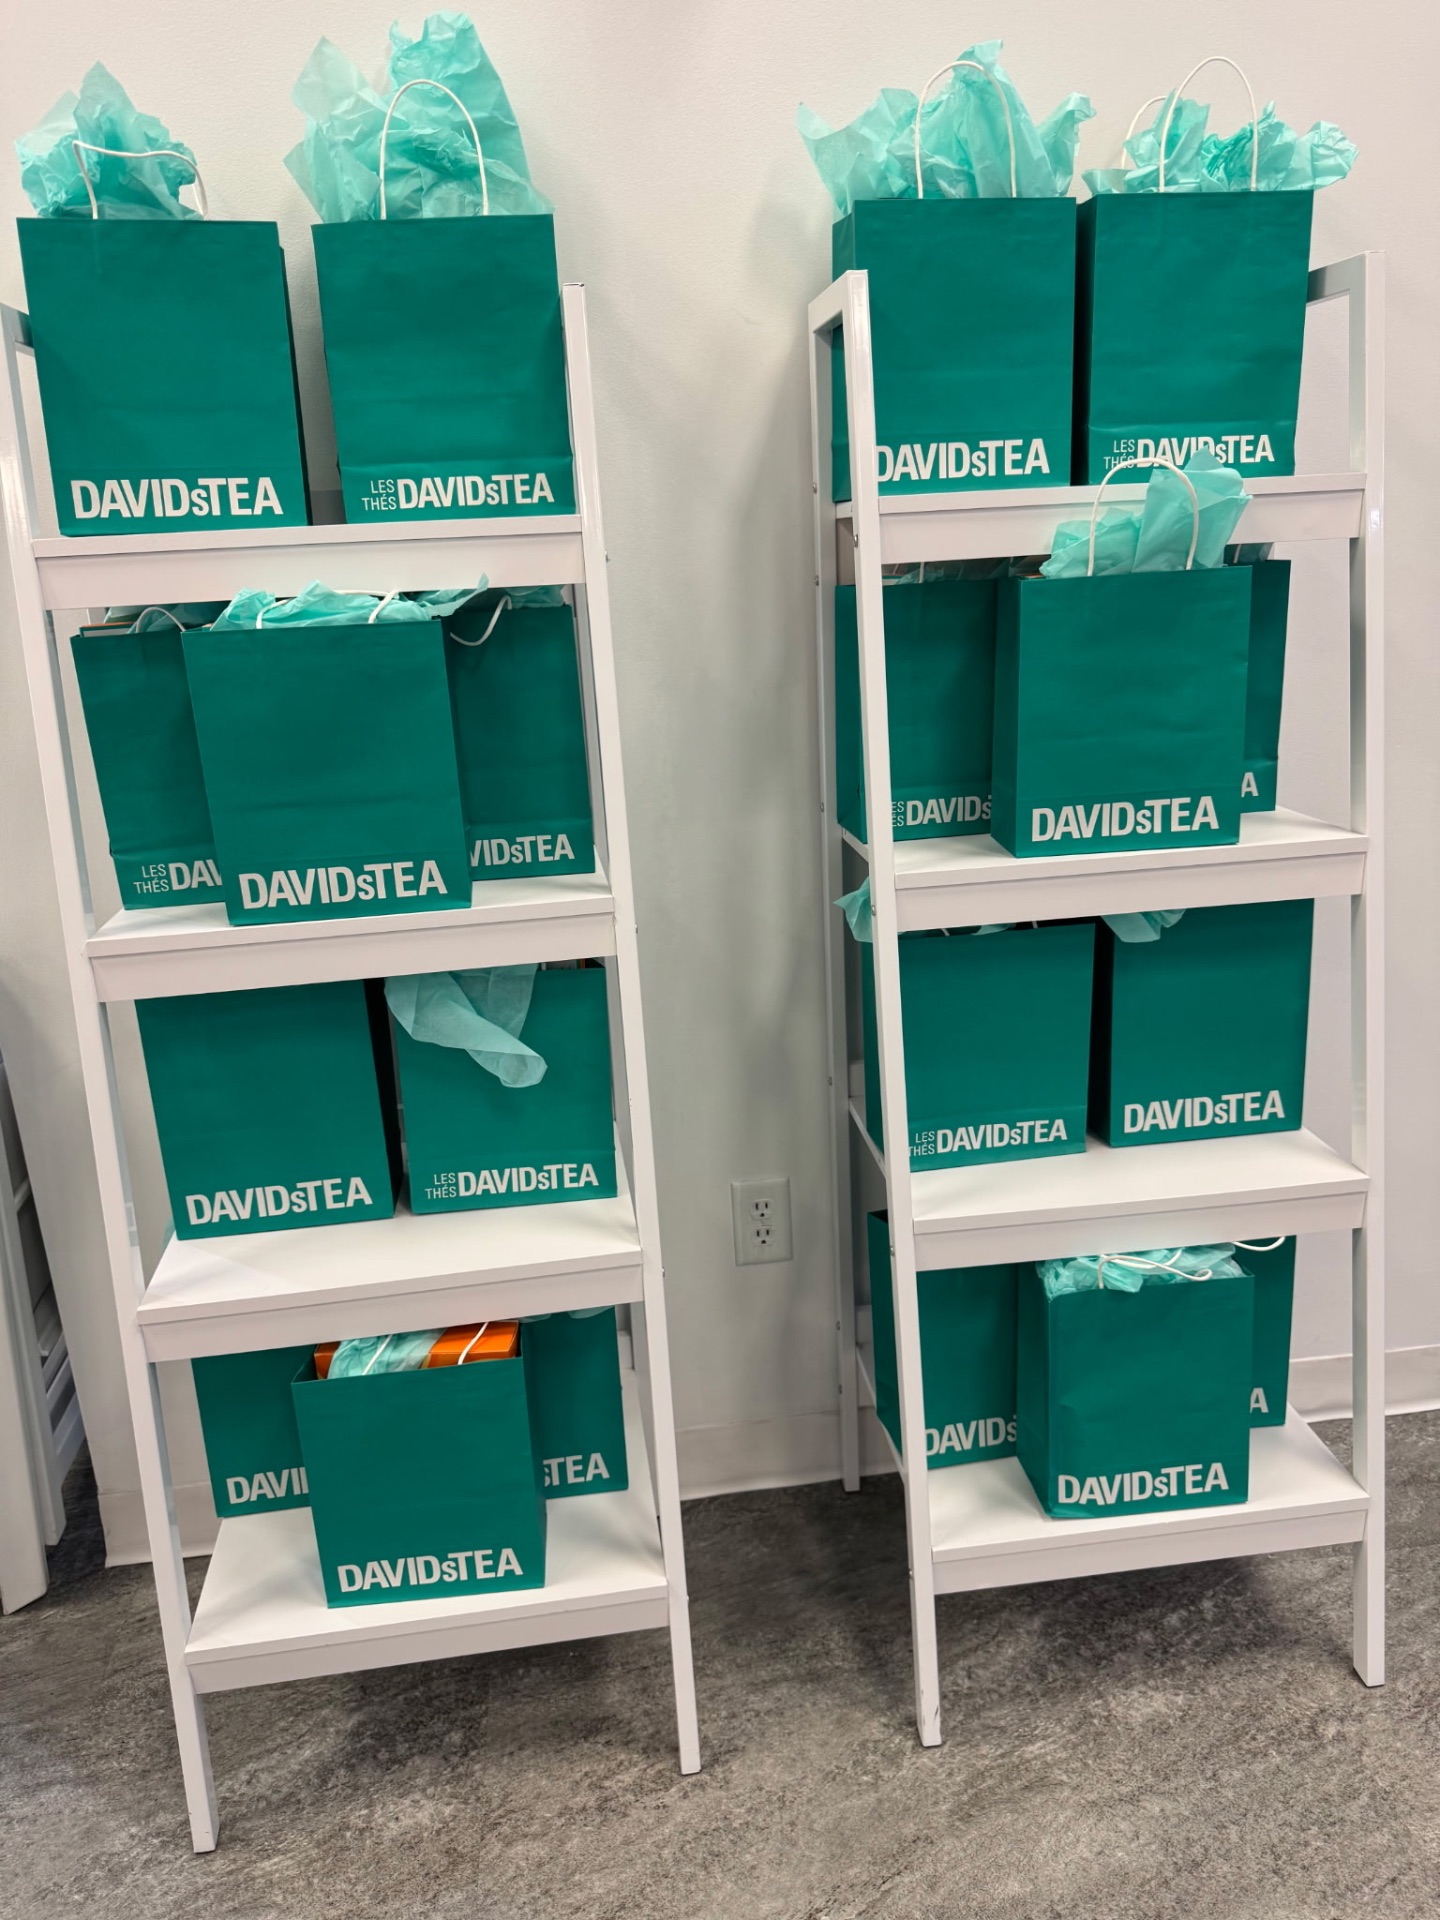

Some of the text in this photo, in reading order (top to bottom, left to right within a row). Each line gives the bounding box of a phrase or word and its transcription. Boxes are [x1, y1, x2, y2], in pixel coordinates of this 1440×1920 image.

[876, 437, 1051, 483] DAVIDsTEA
[1113, 439, 1136, 454] LES
[71, 476, 284, 519] DAVIDsTEA
[361, 491, 397, 511] THÉS
[371, 479, 395, 495] LES
[398, 472, 555, 510] DAVIDsTEA
[906, 795, 992, 826] DAVIDs
[1031, 795, 1220, 842] DAVIDsTEA
[470, 833, 576, 868] VIDsTEA
[133, 877, 170, 894] THÉS
[141, 863, 168, 878] LES
[238, 860, 449, 911] DAVIDsTEA
[1123, 1089, 1286, 1134] DAVIDsTEA
[915, 1130, 936, 1143] LES
[936, 1118, 1068, 1154] DAVIDsTEA
[425, 1183, 457, 1199] THÉS
[433, 1172, 456, 1185] LES
[457, 1163, 600, 1197] DAVIDsTEA
[185, 1175, 374, 1226] DAVIDsTEA
[1057, 1462, 1230, 1506] DAVIDsTEA
[336, 1547, 524, 1593] DAVIDsTEA
